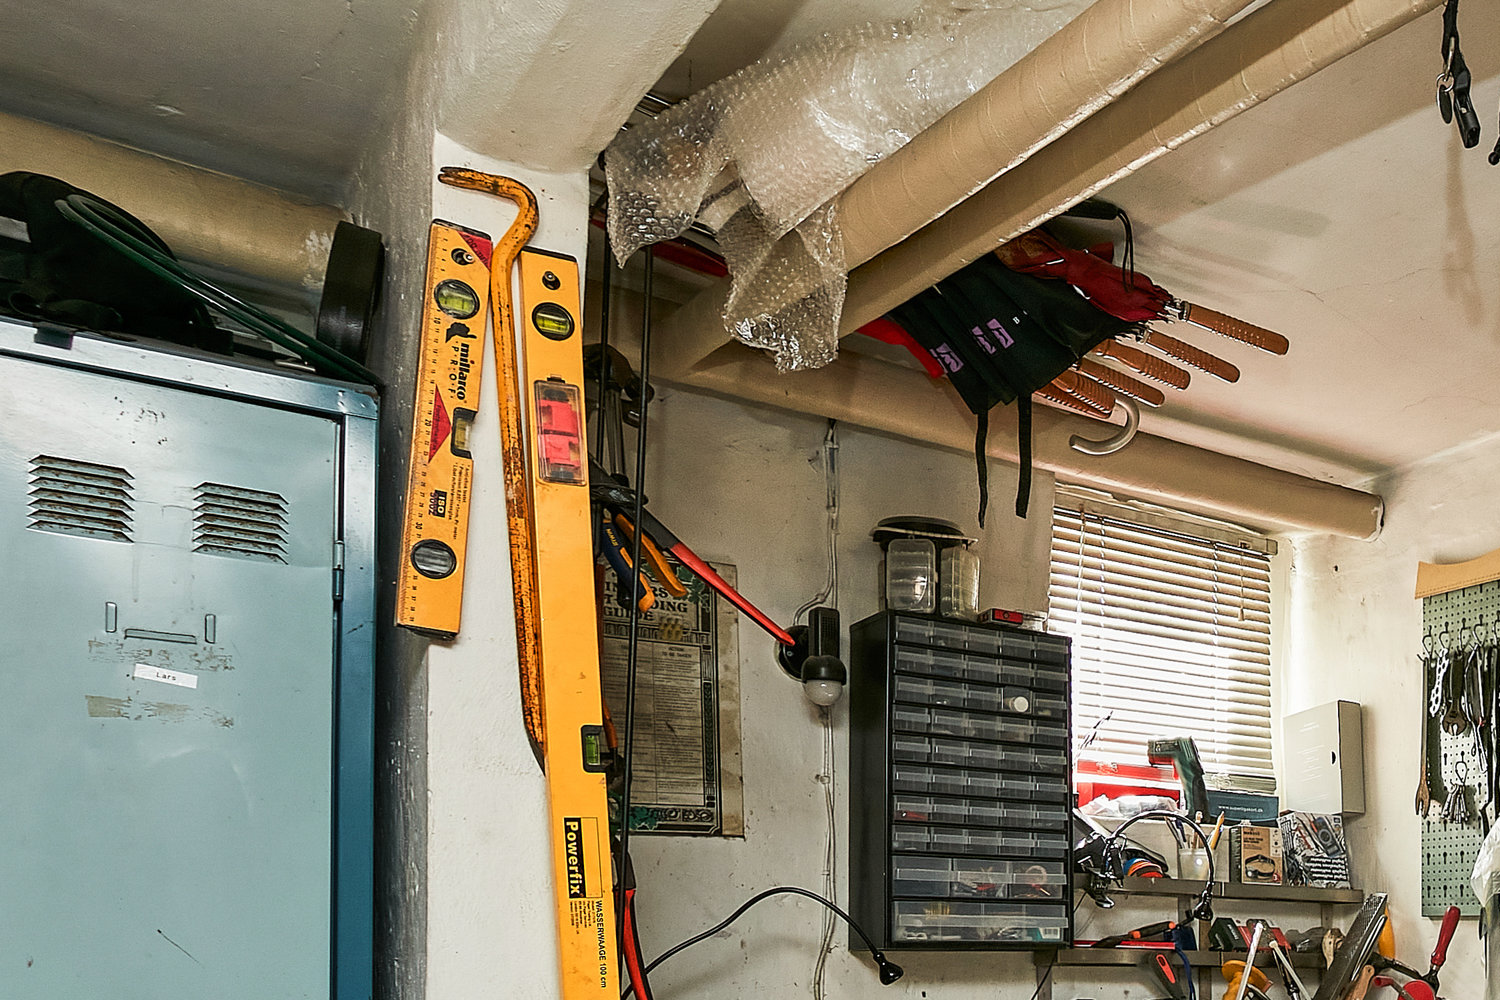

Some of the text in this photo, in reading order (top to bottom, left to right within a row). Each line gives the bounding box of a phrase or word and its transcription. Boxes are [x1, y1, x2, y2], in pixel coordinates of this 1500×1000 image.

[457, 342, 475, 400] millarco
[437, 495, 445, 514] ISO
[156, 672, 177, 681] Lars
[566, 821, 582, 894] Powerfix
[595, 900, 607, 988] WASSERWAAGE 100 cm
